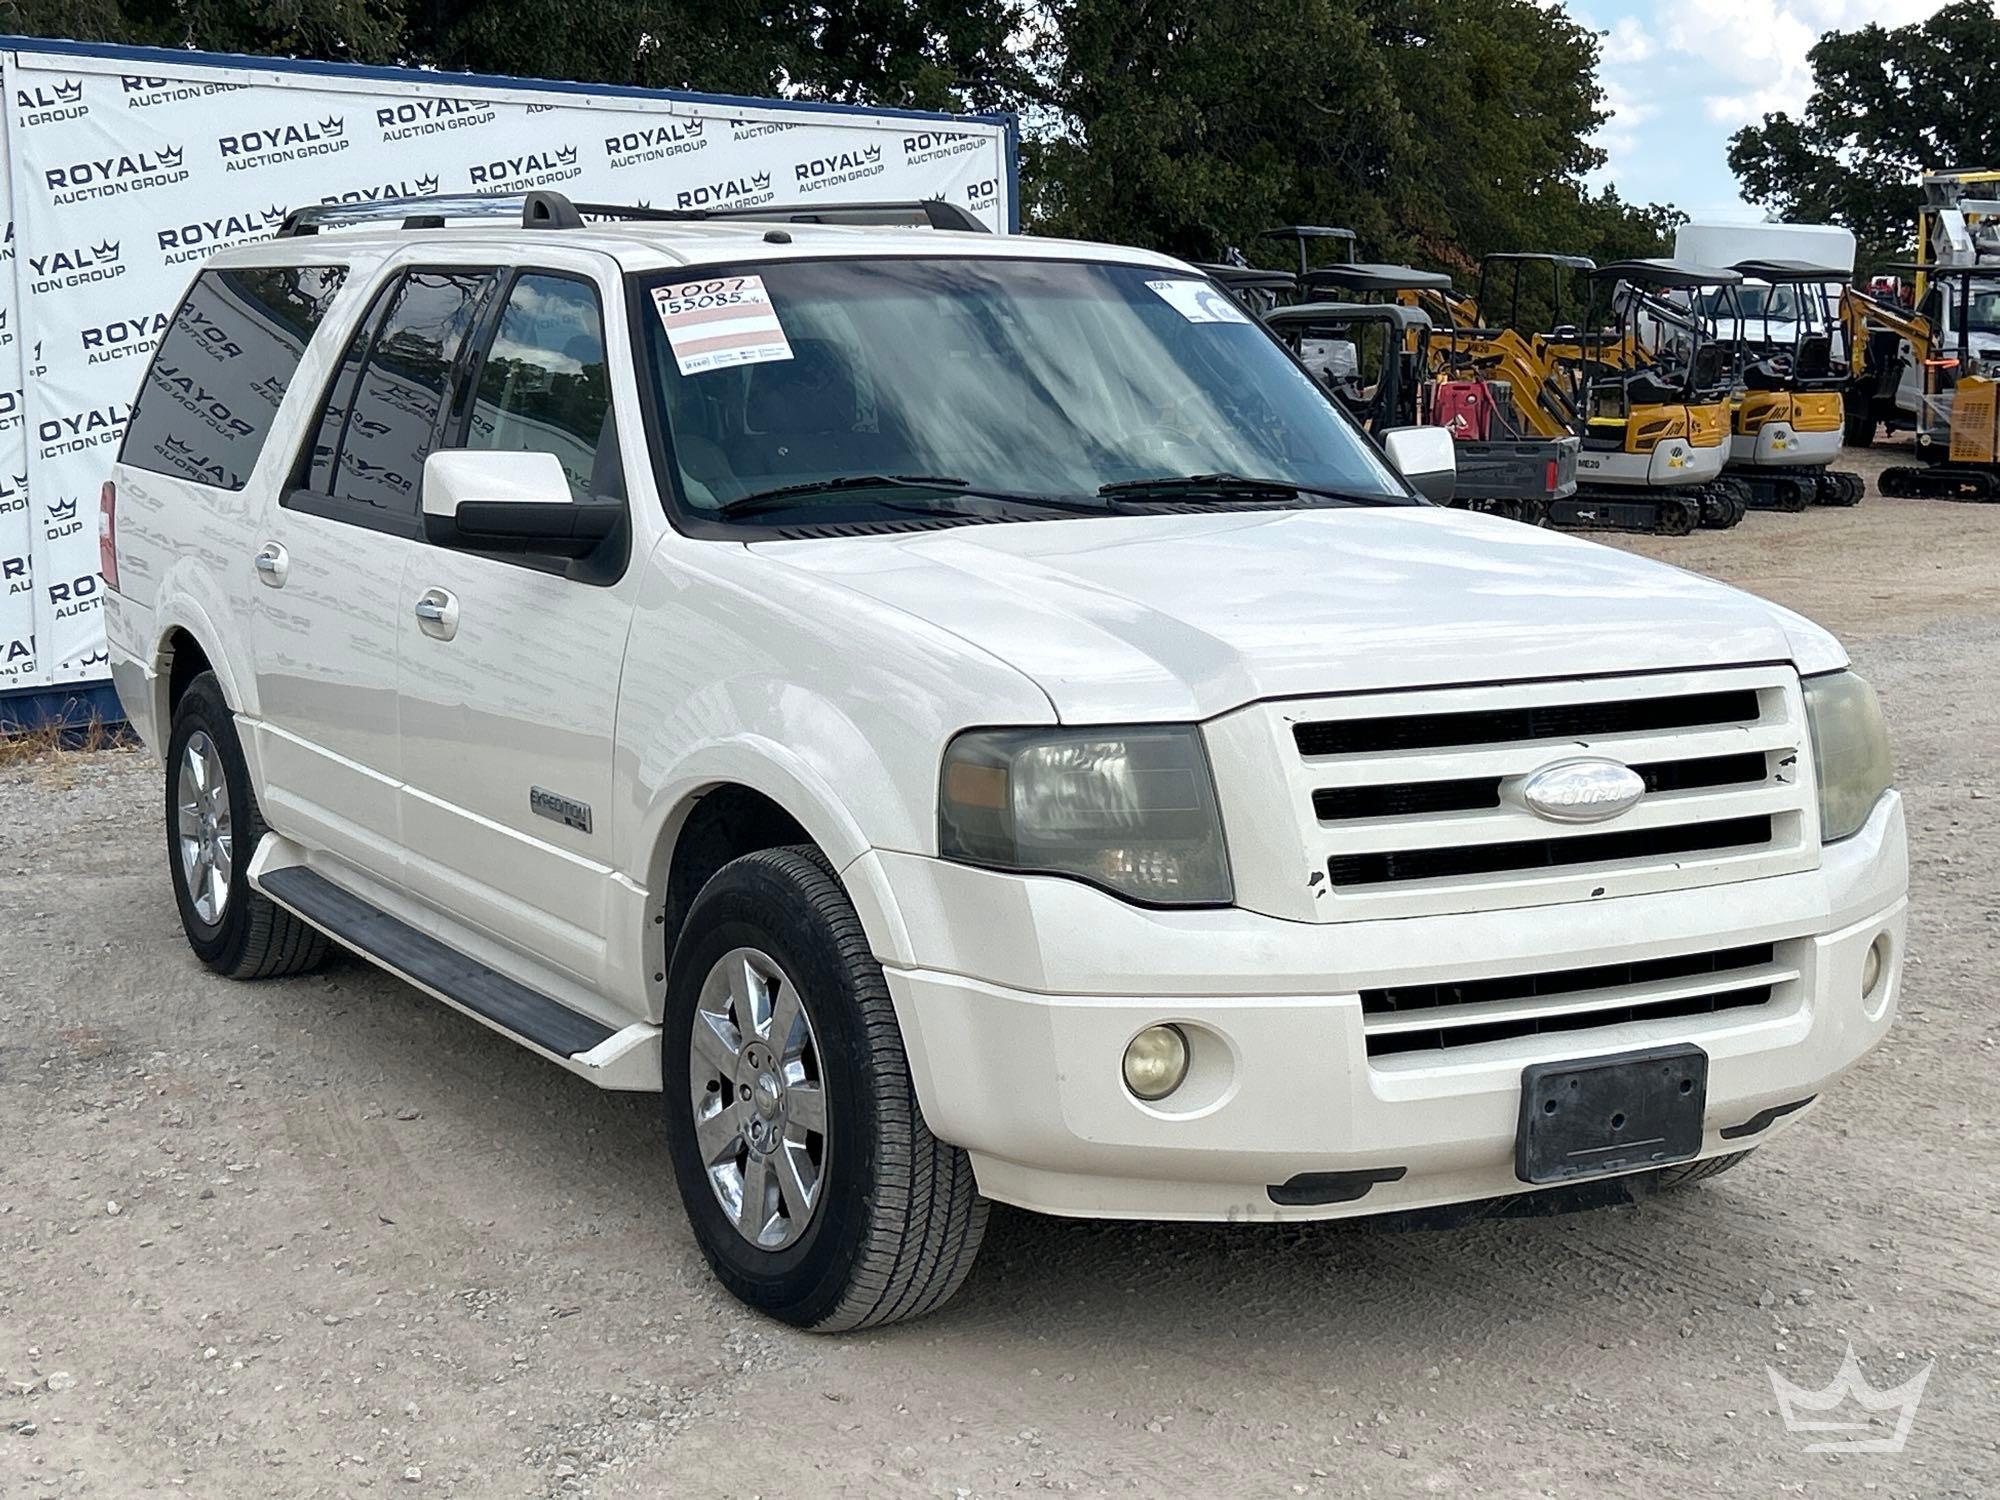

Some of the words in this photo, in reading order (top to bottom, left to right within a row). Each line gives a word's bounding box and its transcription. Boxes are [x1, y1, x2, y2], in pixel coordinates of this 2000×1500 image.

[129, 87, 200, 108] AUCTION
[376, 97, 469, 127] ROYAL
[28, 105, 89, 126] GROUP
[383, 121, 446, 143] AUCTION
[447, 111, 496, 130] GROUP
[219, 123, 320, 157] ROYAL
[605, 125, 685, 156] ROYAL
[733, 123, 785, 141] AUCTION
[226, 150, 294, 172] AUCTION
[297, 139, 349, 159] GROUP
[469, 152, 557, 184] ROYAL
[610, 149, 664, 169] AUCTION
[666, 139, 708, 157] GROUP
[795, 150, 864, 181] ROYAL
[907, 148, 951, 167] AUCTION
[952, 138, 987, 155] GROUP
[45, 153, 158, 191] ROYAL
[536, 167, 582, 186] GROUP
[799, 171, 847, 193] AUCTION
[848, 164, 885, 181] GROUP
[53, 181, 128, 206] AUCTION
[131, 170, 189, 191] GROUP
[677, 178, 752, 209] ROYAL
[734, 191, 774, 209] GROUP
[157, 213, 263, 250] ROYAL
[66, 265, 126, 287] GROUP
[656, 279, 745, 301] 2007
[81, 312, 169, 349] ROYA
[39, 406, 127, 442] OYAL
